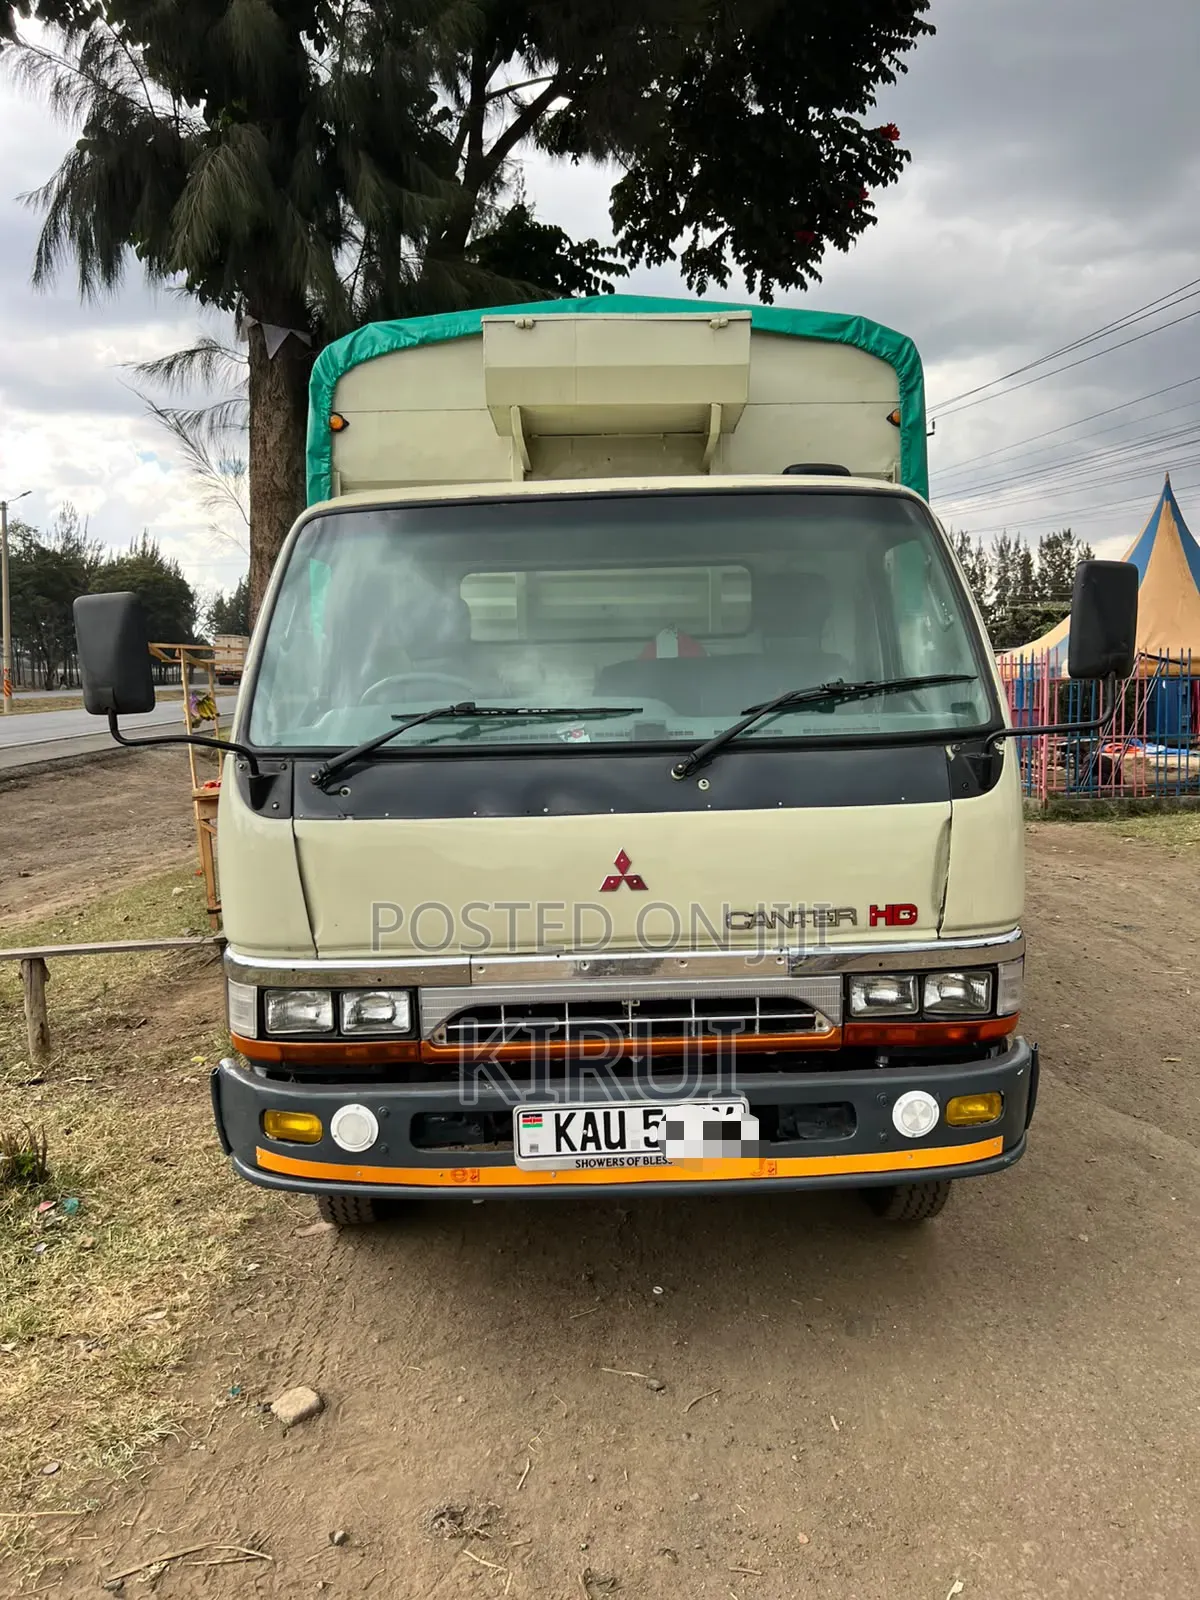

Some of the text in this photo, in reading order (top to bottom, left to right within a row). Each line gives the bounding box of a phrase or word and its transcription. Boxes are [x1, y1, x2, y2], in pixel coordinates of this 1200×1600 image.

[726, 903, 918, 930] CANTER HD
[554, 1110, 627, 1152] KAU
[575, 1157, 625, 1168] SHOWERS
[626, 1156, 641, 1166] OF
